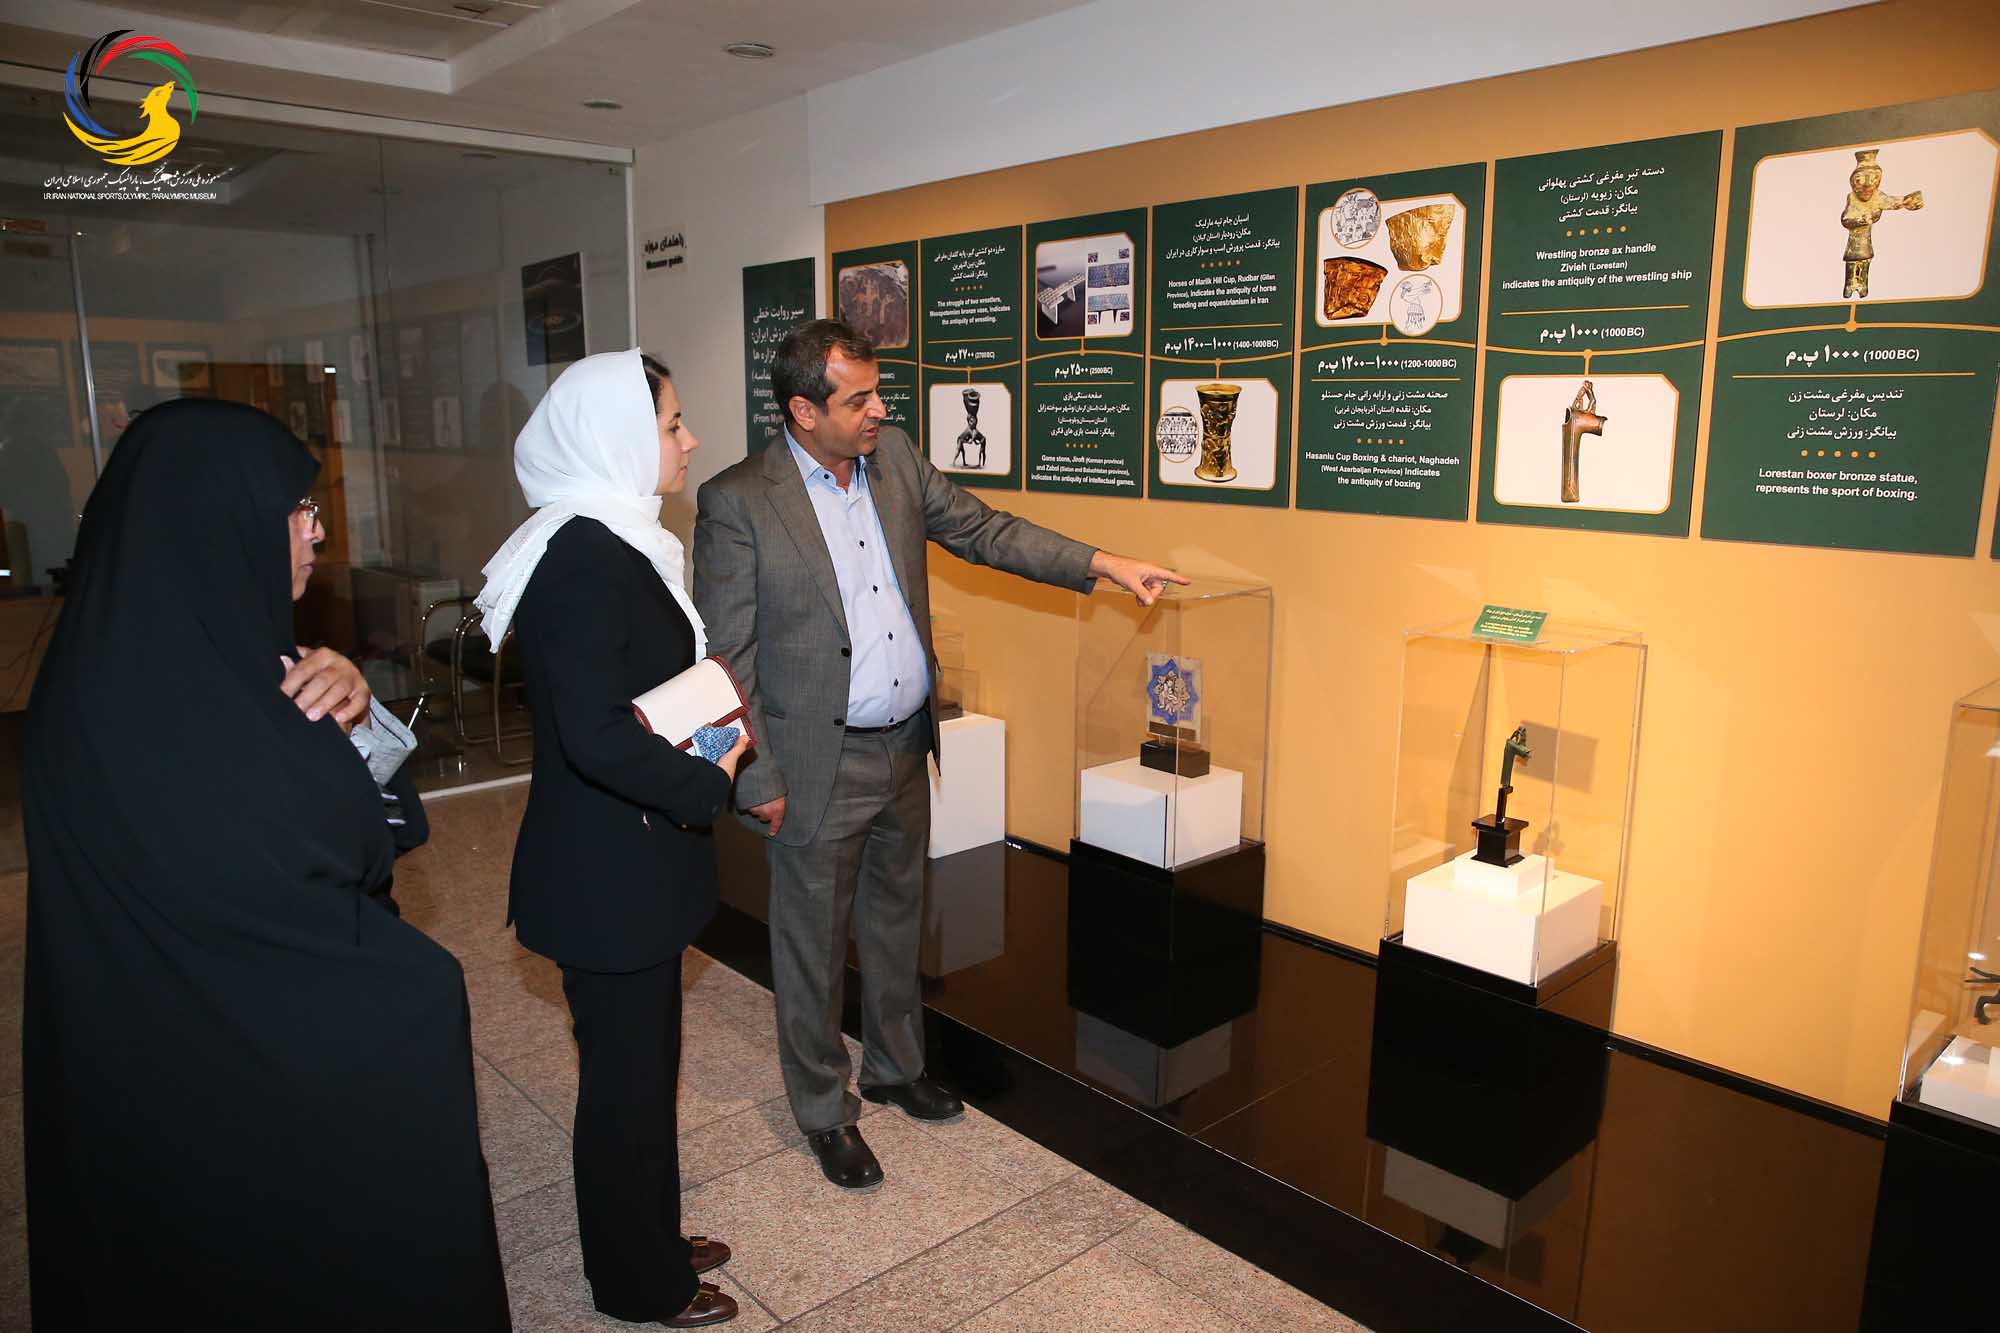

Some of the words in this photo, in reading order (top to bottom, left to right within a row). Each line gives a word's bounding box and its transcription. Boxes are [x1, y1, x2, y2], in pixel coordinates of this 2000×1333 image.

[1626, 169, 1639, 181] تبر
[1641, 167, 1665, 176] دسته
[1569, 173, 1595, 188] کشتی
[1596, 171, 1624, 185] مفرغی
[1538, 177, 1567, 192] پهلوانی
[1560, 192, 1589, 204] (لرستان)
[1590, 190, 1612, 202] زیویه
[1614, 185, 1639, 199] مکان:
[1558, 207, 1584, 222] کشتی
[1585, 205, 1610, 216] قدمت
[1611, 202, 1638, 216] بیانگر:
[1536, 249, 1577, 260] Wrestling
[1579, 248, 1610, 258] bronze
[1611, 247, 1623, 255] ax
[1625, 243, 1657, 254] handle
[1560, 263, 1587, 273] Zivieh
[1588, 261, 1628, 273] (Lorestan)
[1188, 278, 1195, 286] of
[1502, 279, 1540, 290] indicates
[1541, 278, 1556, 287] the
[1557, 275, 1596, 288] antiquity
[1597, 275, 1608, 285] of
[1608, 274, 1624, 284] the
[1625, 271, 1669, 283] wrestling
[1670, 269, 1693, 281] ship
[1252, 285, 1258, 293] of
[1197, 300, 1208, 308] and
[1344, 390, 1356, 401] جام
[1405, 391, 1425, 399] مشت
[1427, 391, 1449, 399] صحنه
[1788, 391, 1802, 403] زن
[1803, 389, 1831, 399] مشت
[1831, 388, 1866, 403] مفرغی
[1866, 389, 1905, 403] تندیس
[1808, 407, 1845, 421] لرستان
[1847, 407, 1878, 421] مکان:
[1346, 419, 1365, 427] مشت
[1365, 419, 1385, 429] ورزش
[1386, 419, 1407, 428] قدمت
[1409, 419, 1432, 430] بیانگر:
[1786, 426, 1805, 439] زنی
[1805, 426, 1833, 436] مشت
[1833, 426, 1863, 440] ورزش
[1864, 425, 1897, 440] بیانگر:
[1305, 451, 1335, 461] Hasanlu
[1335, 452, 1351, 462] Cup
[1352, 453, 1379, 463] Boxing
[1380, 454, 1387, 462] &
[1419, 455, 1460, 465] Naghadeh
[1759, 468, 1804, 479] Lorestan
[1806, 469, 1838, 480] boxer
[1839, 471, 1877, 482] bronze
[1879, 472, 1918, 484] statue,
[1337, 476, 1349, 484] the
[1351, 477, 1383, 487] antiquity
[1384, 478, 1393, 486] of
[1394, 479, 1421, 489] boxing
[1755, 484, 1810, 495] represents
[1812, 485, 1830, 495] the
[1831, 486, 1860, 498] sport
[1862, 487, 1875, 497] of
[1876, 488, 1918, 501] boxing.
